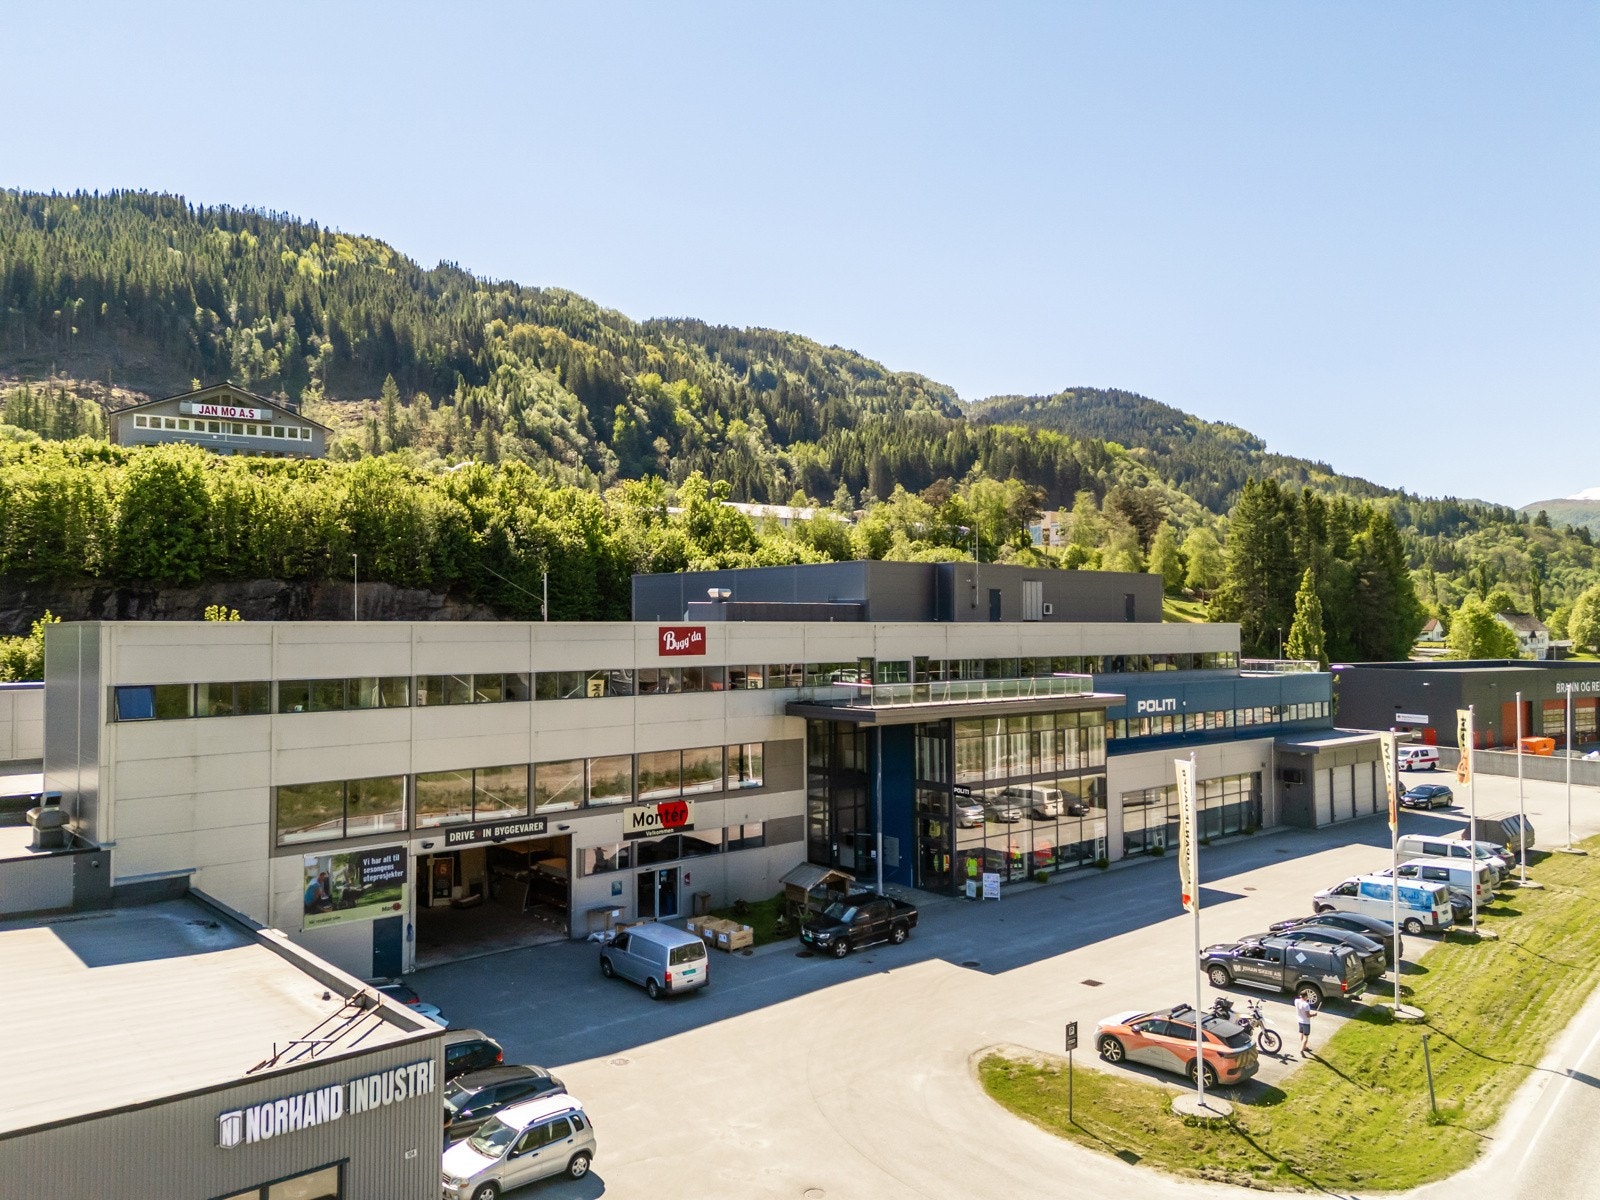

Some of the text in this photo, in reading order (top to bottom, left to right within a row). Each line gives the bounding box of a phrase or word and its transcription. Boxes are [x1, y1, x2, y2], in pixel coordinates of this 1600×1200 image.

[198, 405, 255, 419] JAN MO A.S
[1580, 681, 1591, 692] OG
[1137, 698, 1176, 713] POLITI
[953, 786, 970, 795] POLITI
[632, 808, 686, 828] Montér
[449, 822, 544, 843] DRIVE IN BYGGEVARER
[645, 828, 674, 838] Velkommen
[363, 857, 370, 866] Vi
[371, 857, 381, 865] har
[382, 855, 392, 863] alt
[363, 864, 394, 874] sesongens
[246, 1085, 344, 1144] NORHAND
[349, 1059, 435, 1115] INDUSTRI
